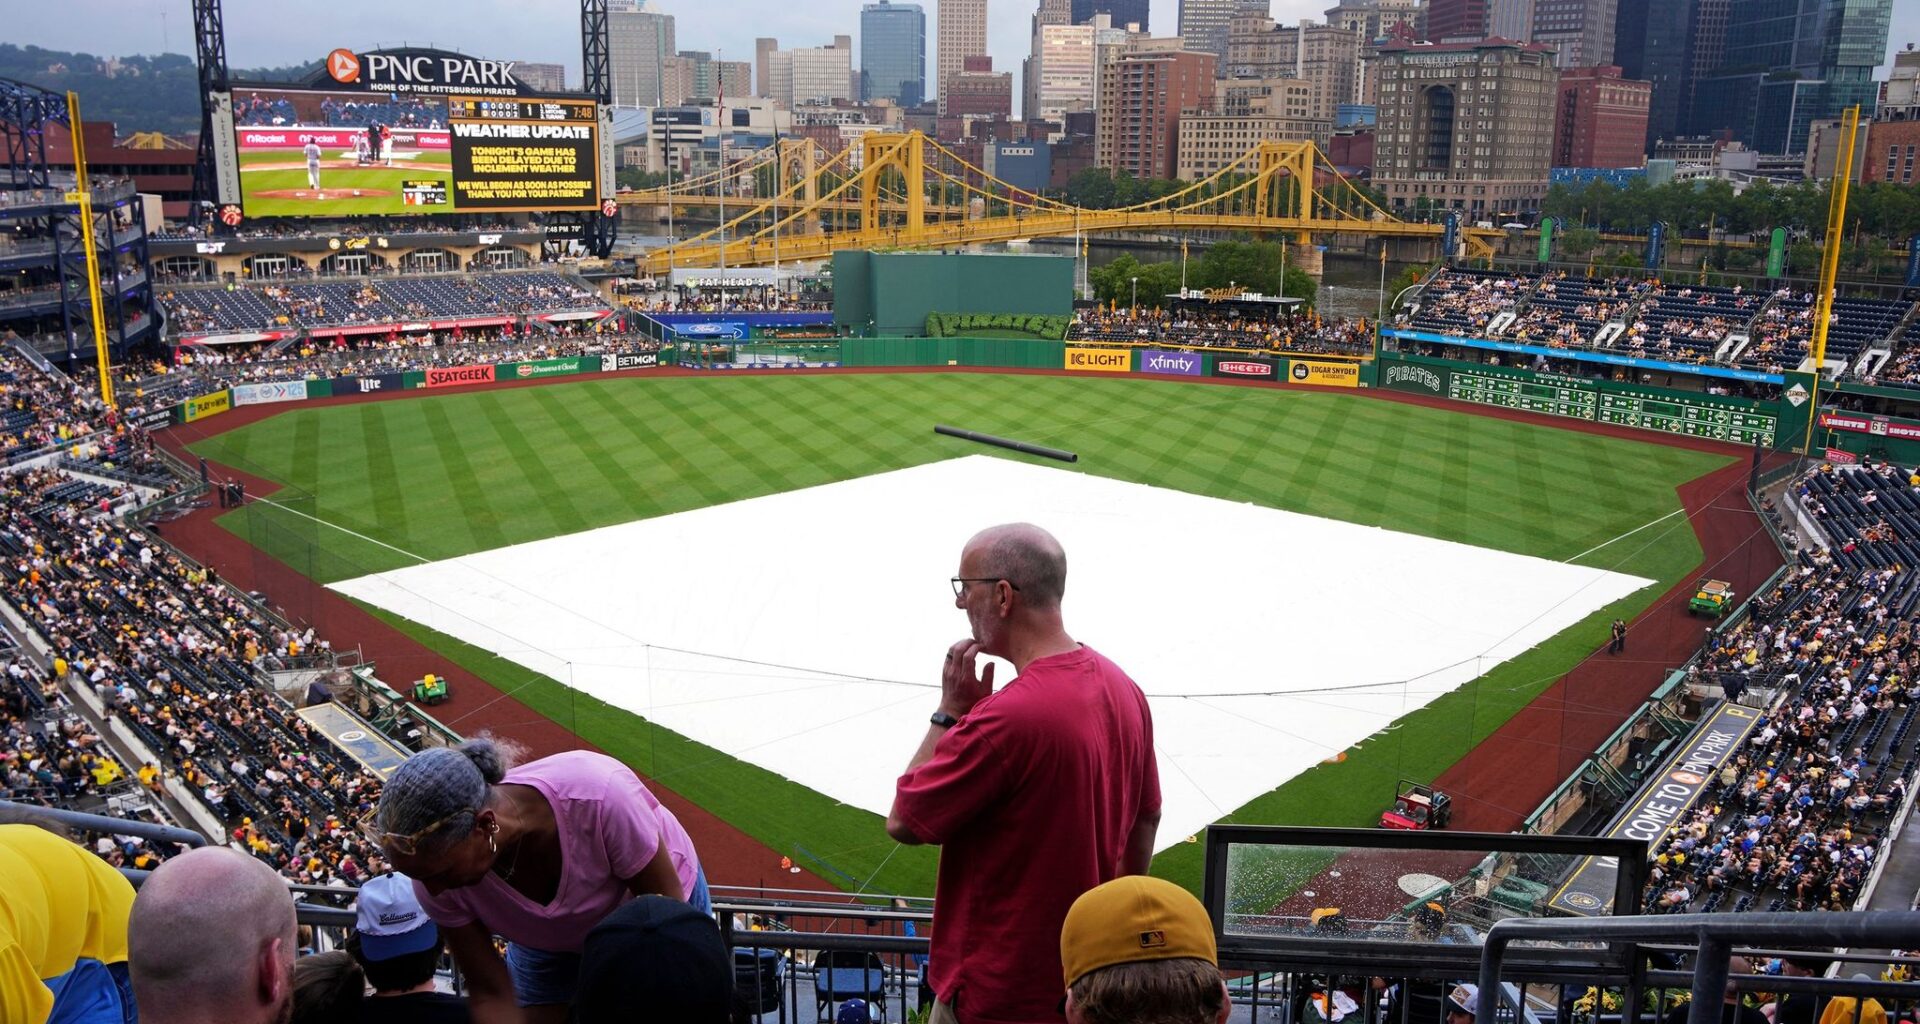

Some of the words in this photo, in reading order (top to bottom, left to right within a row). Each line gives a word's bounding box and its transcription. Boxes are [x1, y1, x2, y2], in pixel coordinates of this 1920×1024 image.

[365, 54, 434, 83] PNC
[440, 58, 517, 86] PARK
[370, 83, 396, 91] HOME
[398, 84, 410, 92] OF
[413, 84, 429, 93] THE
[431, 85, 482, 94] PITTSBURGH
[484, 87, 517, 95] PIRATES
[526, 103, 532, 116] 1
[573, 107, 592, 119] 7:48
[453, 124, 530, 138] WEATHER
[532, 126, 590, 139] UPDATE
[254, 134, 286, 144] Rocket
[428, 136, 448, 145] Rocket
[471, 147, 524, 156] TONIGHT'S
[525, 147, 554, 156] GAME
[555, 148, 576, 156] HAS
[471, 156, 497, 164] BEEN
[499, 156, 542, 165] DELAYED
[543, 156, 563, 165] DUE
[564, 157, 576, 165] TO
[473, 165, 529, 173] INCLEMENT
[530, 165, 576, 173] WEATHER
[457, 181, 471, 189] WE
[471, 181, 489, 190] WILL
[489, 181, 513, 190] BEGIN
[513, 181, 524, 190] AS
[525, 181, 547, 190] SOON
[547, 181, 558, 190] AS
[559, 181, 592, 189] POSSIBLE
[467, 190, 494, 199] THANK
[495, 190, 511, 198] YOU
[512, 190, 527, 198] FOR
[528, 190, 548, 198] YOUR
[549, 190, 583, 198] PATIENCE
[700, 278, 722, 287] FAT
[722, 278, 764, 287] HEAD'S
[1189, 290, 1205, 299] IT'S
[1203, 286, 1248, 304] Miller
[1241, 292, 1262, 302] TIME
[617, 354, 657, 367] BETMGM
[1071, 352, 1085, 365] IC
[1088, 354, 1125, 366] LIGHT
[1149, 354, 1193, 372] xfinity
[561, 361, 579, 370] Good
[1222, 362, 1269, 373] SHEETZ
[1311, 365, 1331, 374] EDGAR
[1332, 367, 1357, 376] SNYDER
[430, 368, 491, 385] SEATGEEK
[1386, 365, 1440, 392] PIRATES
[1467, 369, 1524, 381] NATIONAL
[1533, 378, 1578, 389] LEAGUE
[1535, 373, 1558, 381] WELCOME
[287, 382, 304, 397] 125
[359, 378, 381, 393] Lite
[198, 401, 210, 413] PLAY
[1620, 390, 1690, 404] AMERICAN
[1701, 401, 1755, 413] LEAGUE
[1726, 708, 1753, 719] P
[1656, 783, 1691, 801] TO
[1680, 752, 1716, 773] PNC
[1704, 730, 1735, 756] PARK
